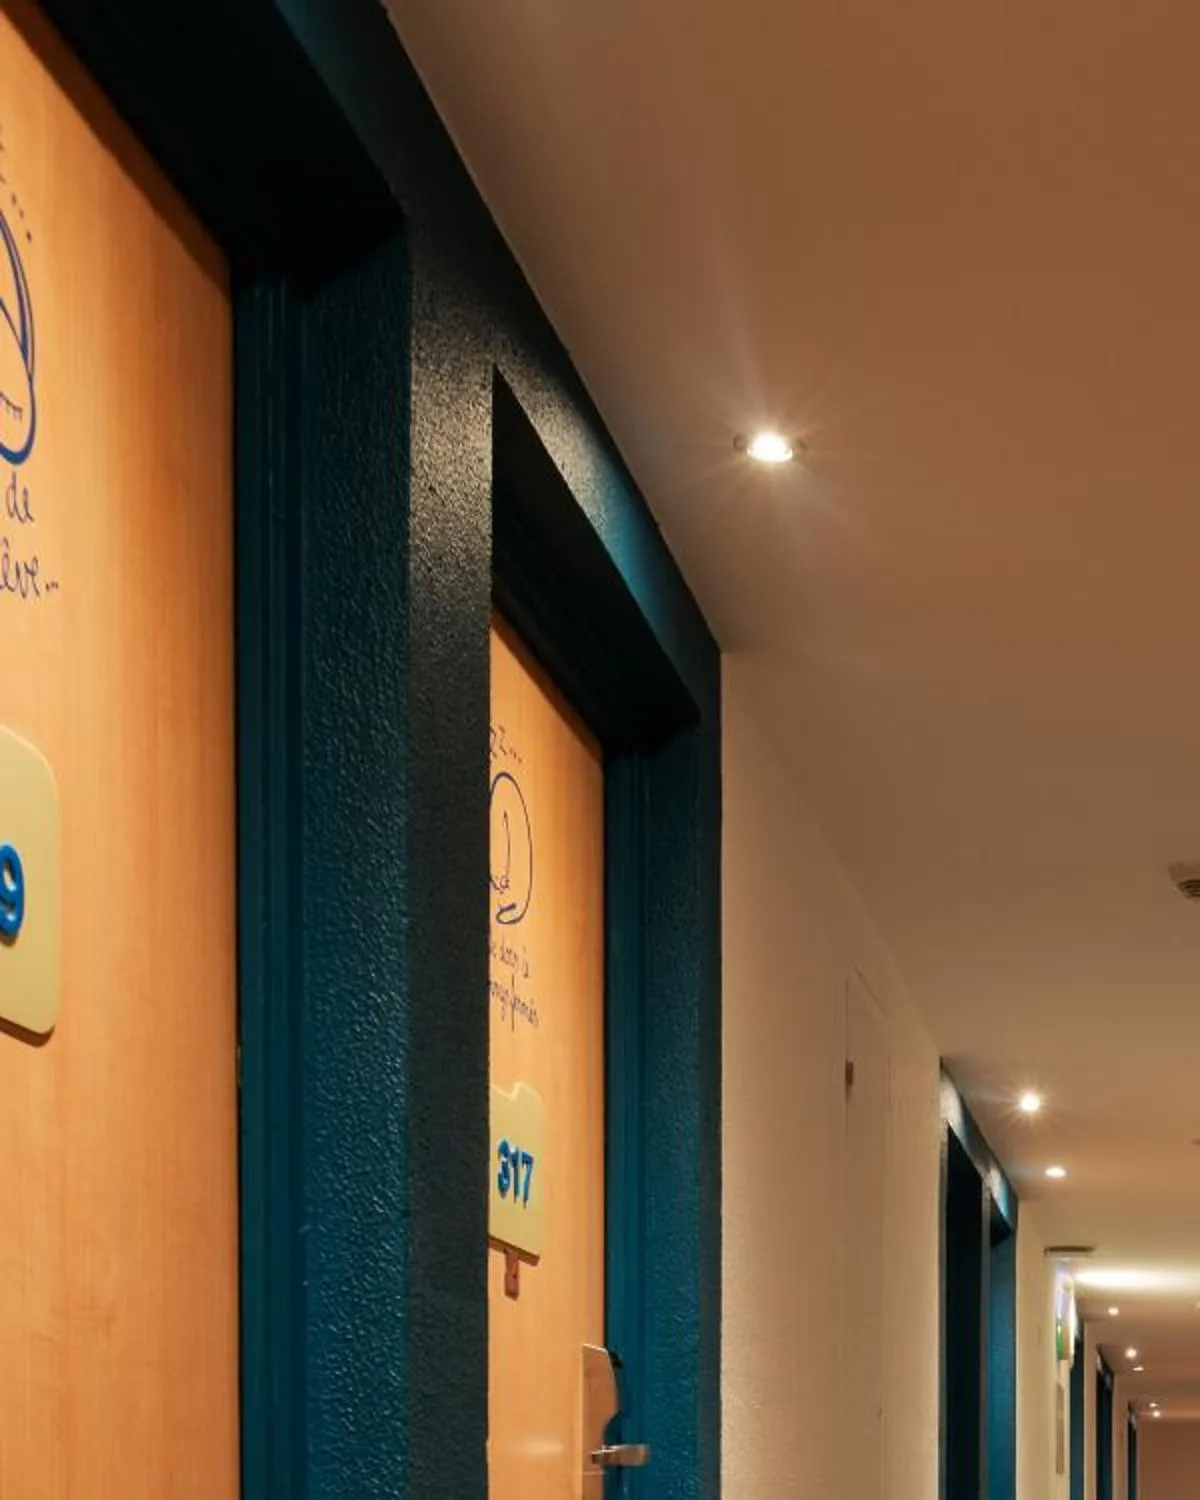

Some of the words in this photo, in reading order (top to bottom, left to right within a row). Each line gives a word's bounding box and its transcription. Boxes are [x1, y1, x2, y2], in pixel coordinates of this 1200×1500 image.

[0, 536, 60, 600] êve...
[0, 845, 25, 939] 9
[497, 1139, 535, 1206] 317
